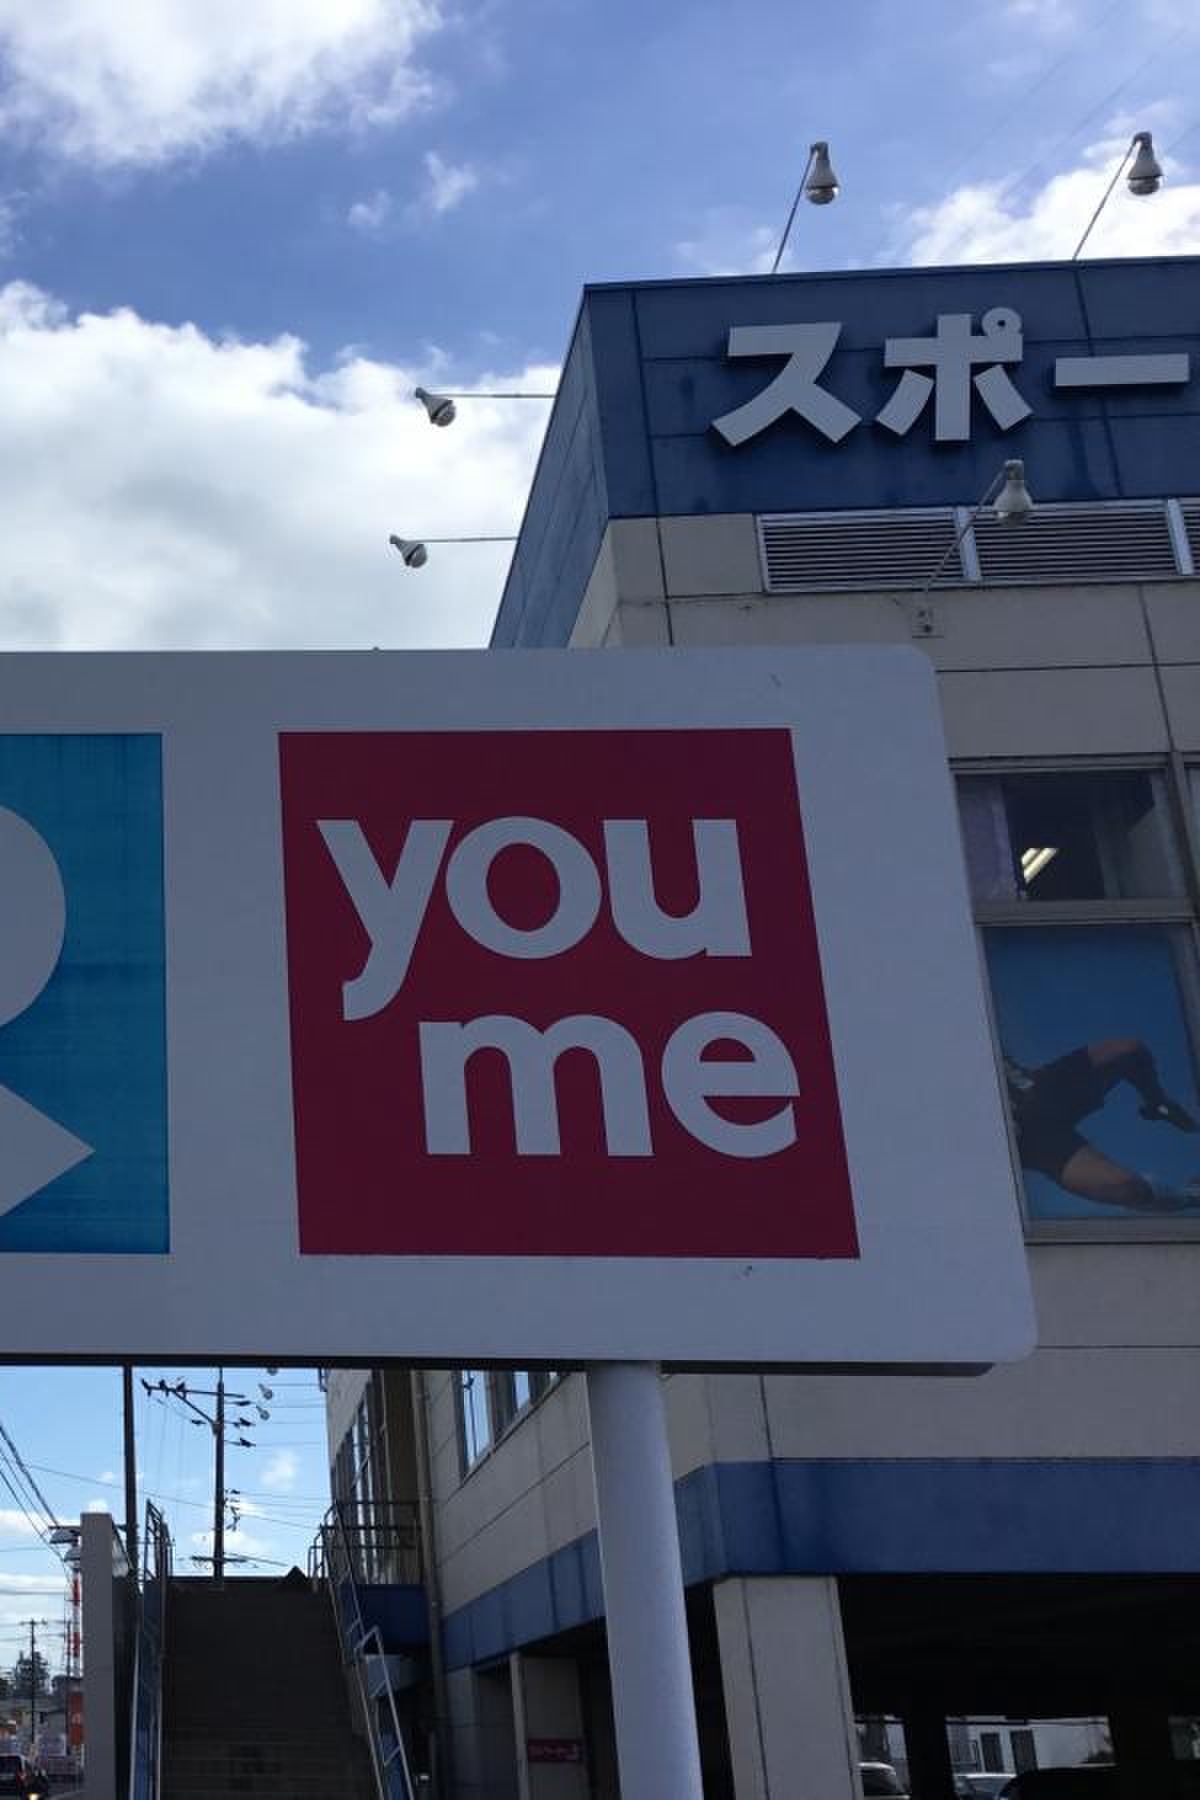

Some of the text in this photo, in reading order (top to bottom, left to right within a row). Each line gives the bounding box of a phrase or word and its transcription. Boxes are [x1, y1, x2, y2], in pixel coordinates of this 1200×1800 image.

[712, 308, 1190, 446] スポー
[315, 815, 753, 1022] you
[417, 1010, 802, 1159] me
